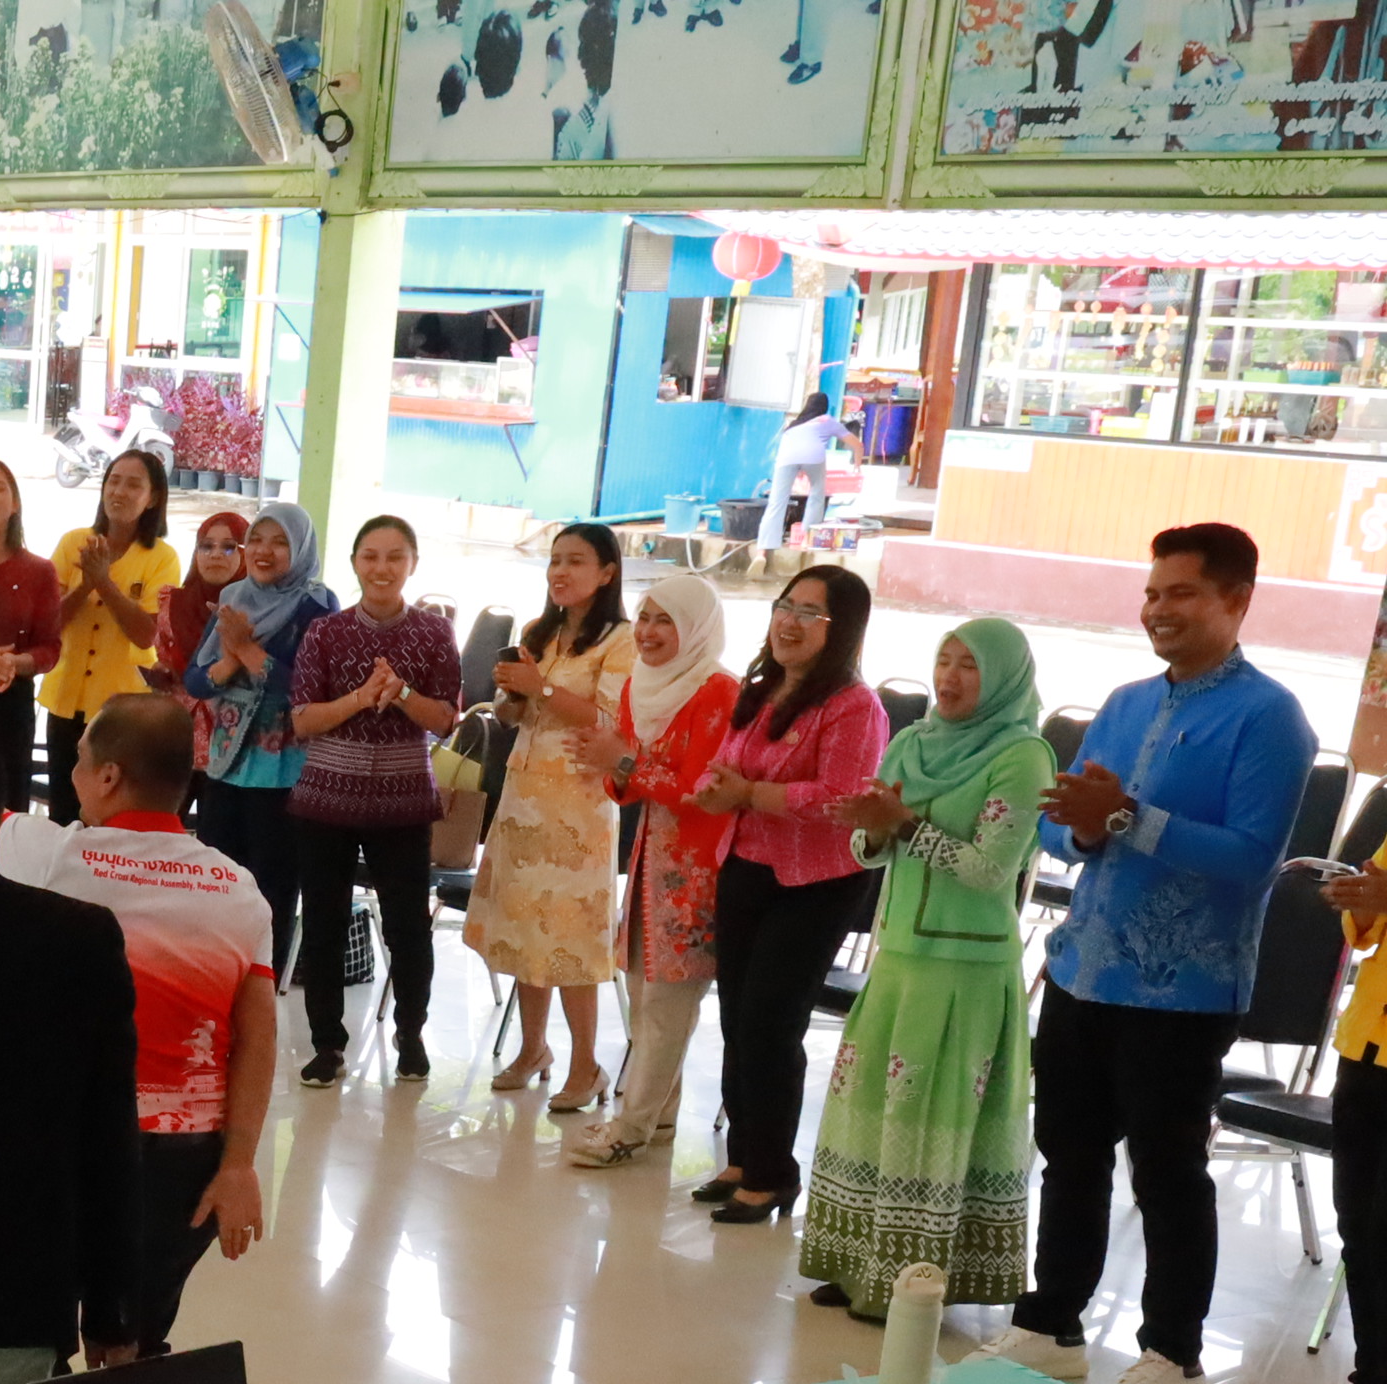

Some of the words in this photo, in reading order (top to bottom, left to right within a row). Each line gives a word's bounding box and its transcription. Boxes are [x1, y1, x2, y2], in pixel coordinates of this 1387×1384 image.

[93, 867, 109, 879] Red
[130, 874, 158, 886] Regional
[160, 878, 196, 892] Assembly,
[197, 881, 220, 894] Region
[221, 884, 230, 895] 12
